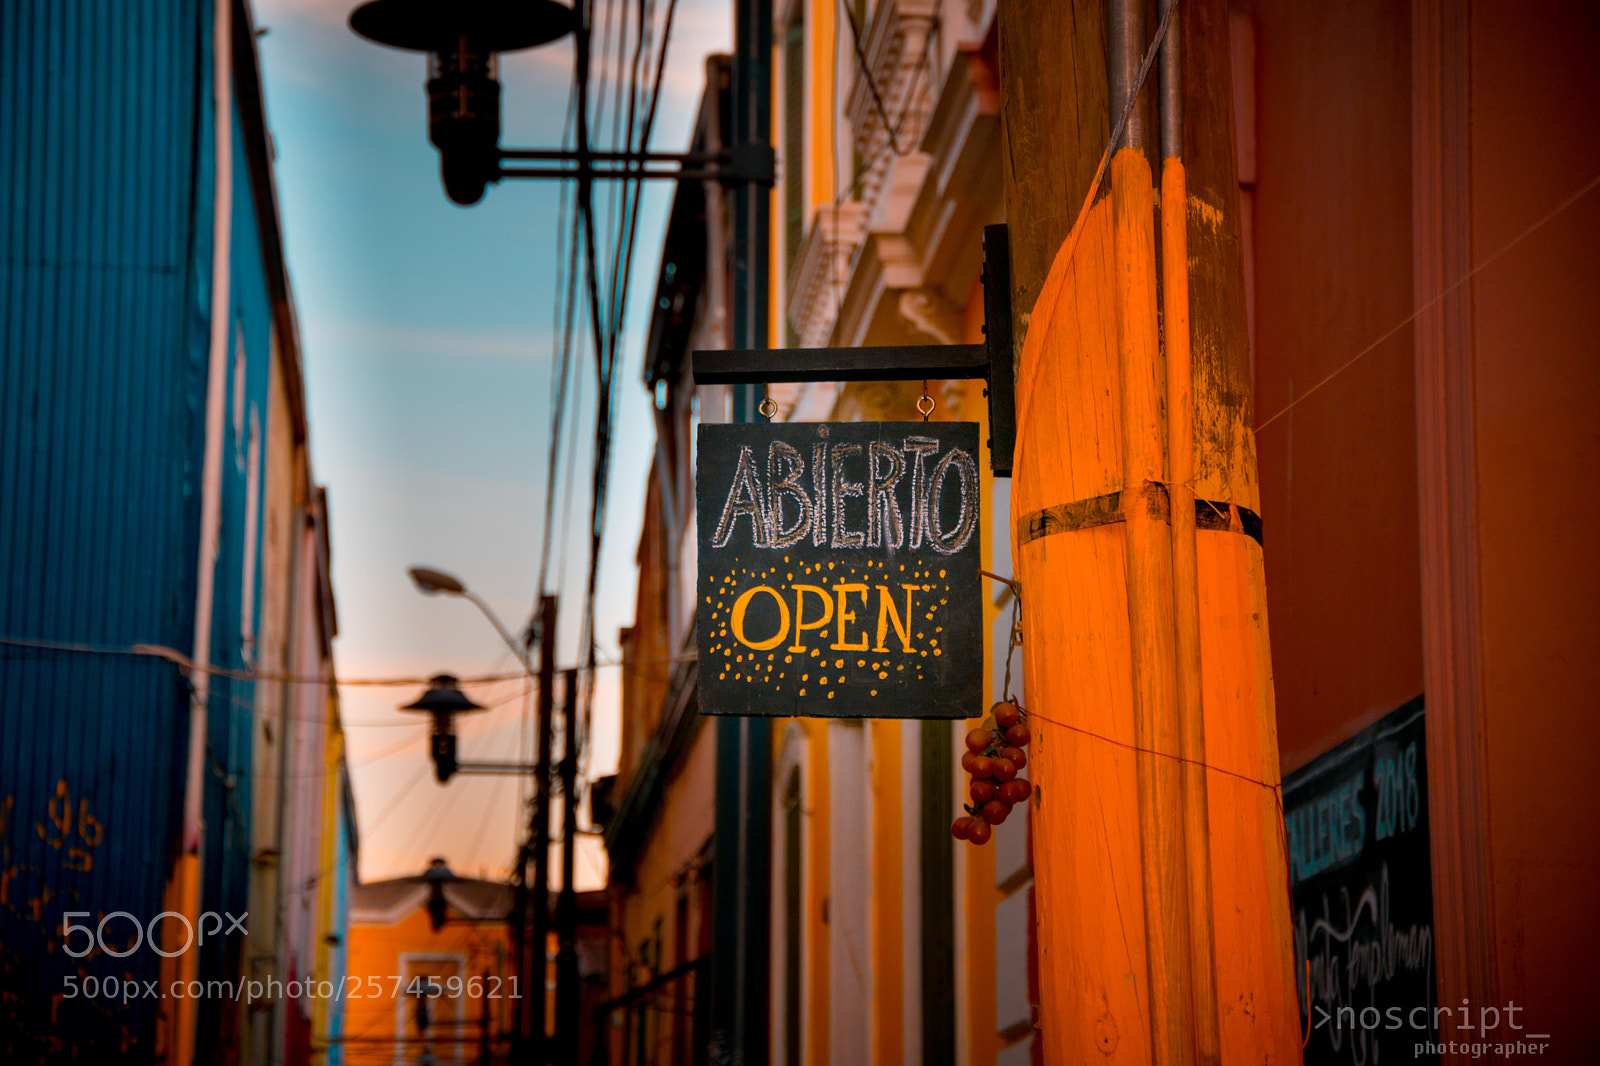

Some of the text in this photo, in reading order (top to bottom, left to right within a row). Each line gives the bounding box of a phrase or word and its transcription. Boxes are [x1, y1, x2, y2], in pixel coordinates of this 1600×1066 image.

[710, 424, 979, 555] ABIERTO
[731, 583, 921, 653] OPEN
[1374, 741, 1420, 842] 2018
